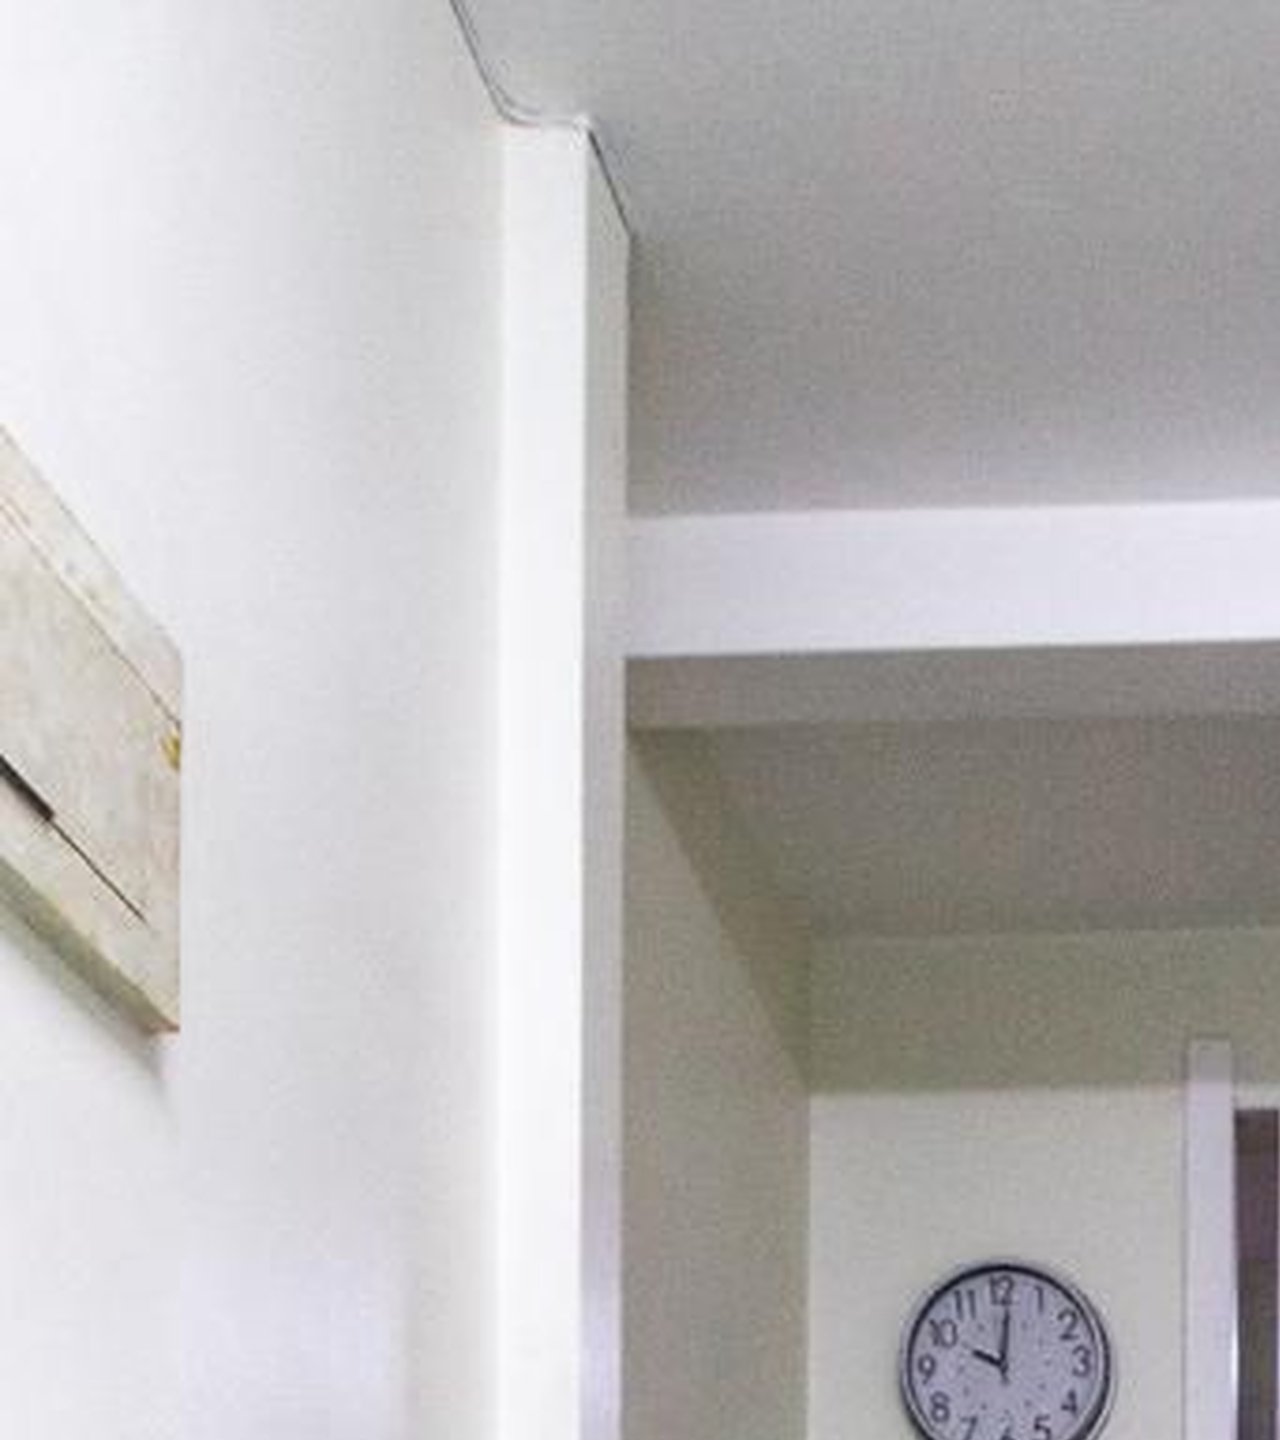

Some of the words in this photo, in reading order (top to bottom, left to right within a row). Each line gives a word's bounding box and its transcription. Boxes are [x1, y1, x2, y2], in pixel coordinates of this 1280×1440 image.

[953, 1289, 977, 1320] 11
[989, 1275, 1016, 1307] 12
[1033, 1286, 1045, 1314] 1
[929, 1317, 959, 1348] 10
[1056, 1308, 1080, 1341] 2
[917, 1354, 937, 1386] 9
[1071, 1345, 1092, 1377] 3
[929, 1391, 951, 1423] 8
[1061, 1388, 1079, 1418] 4
